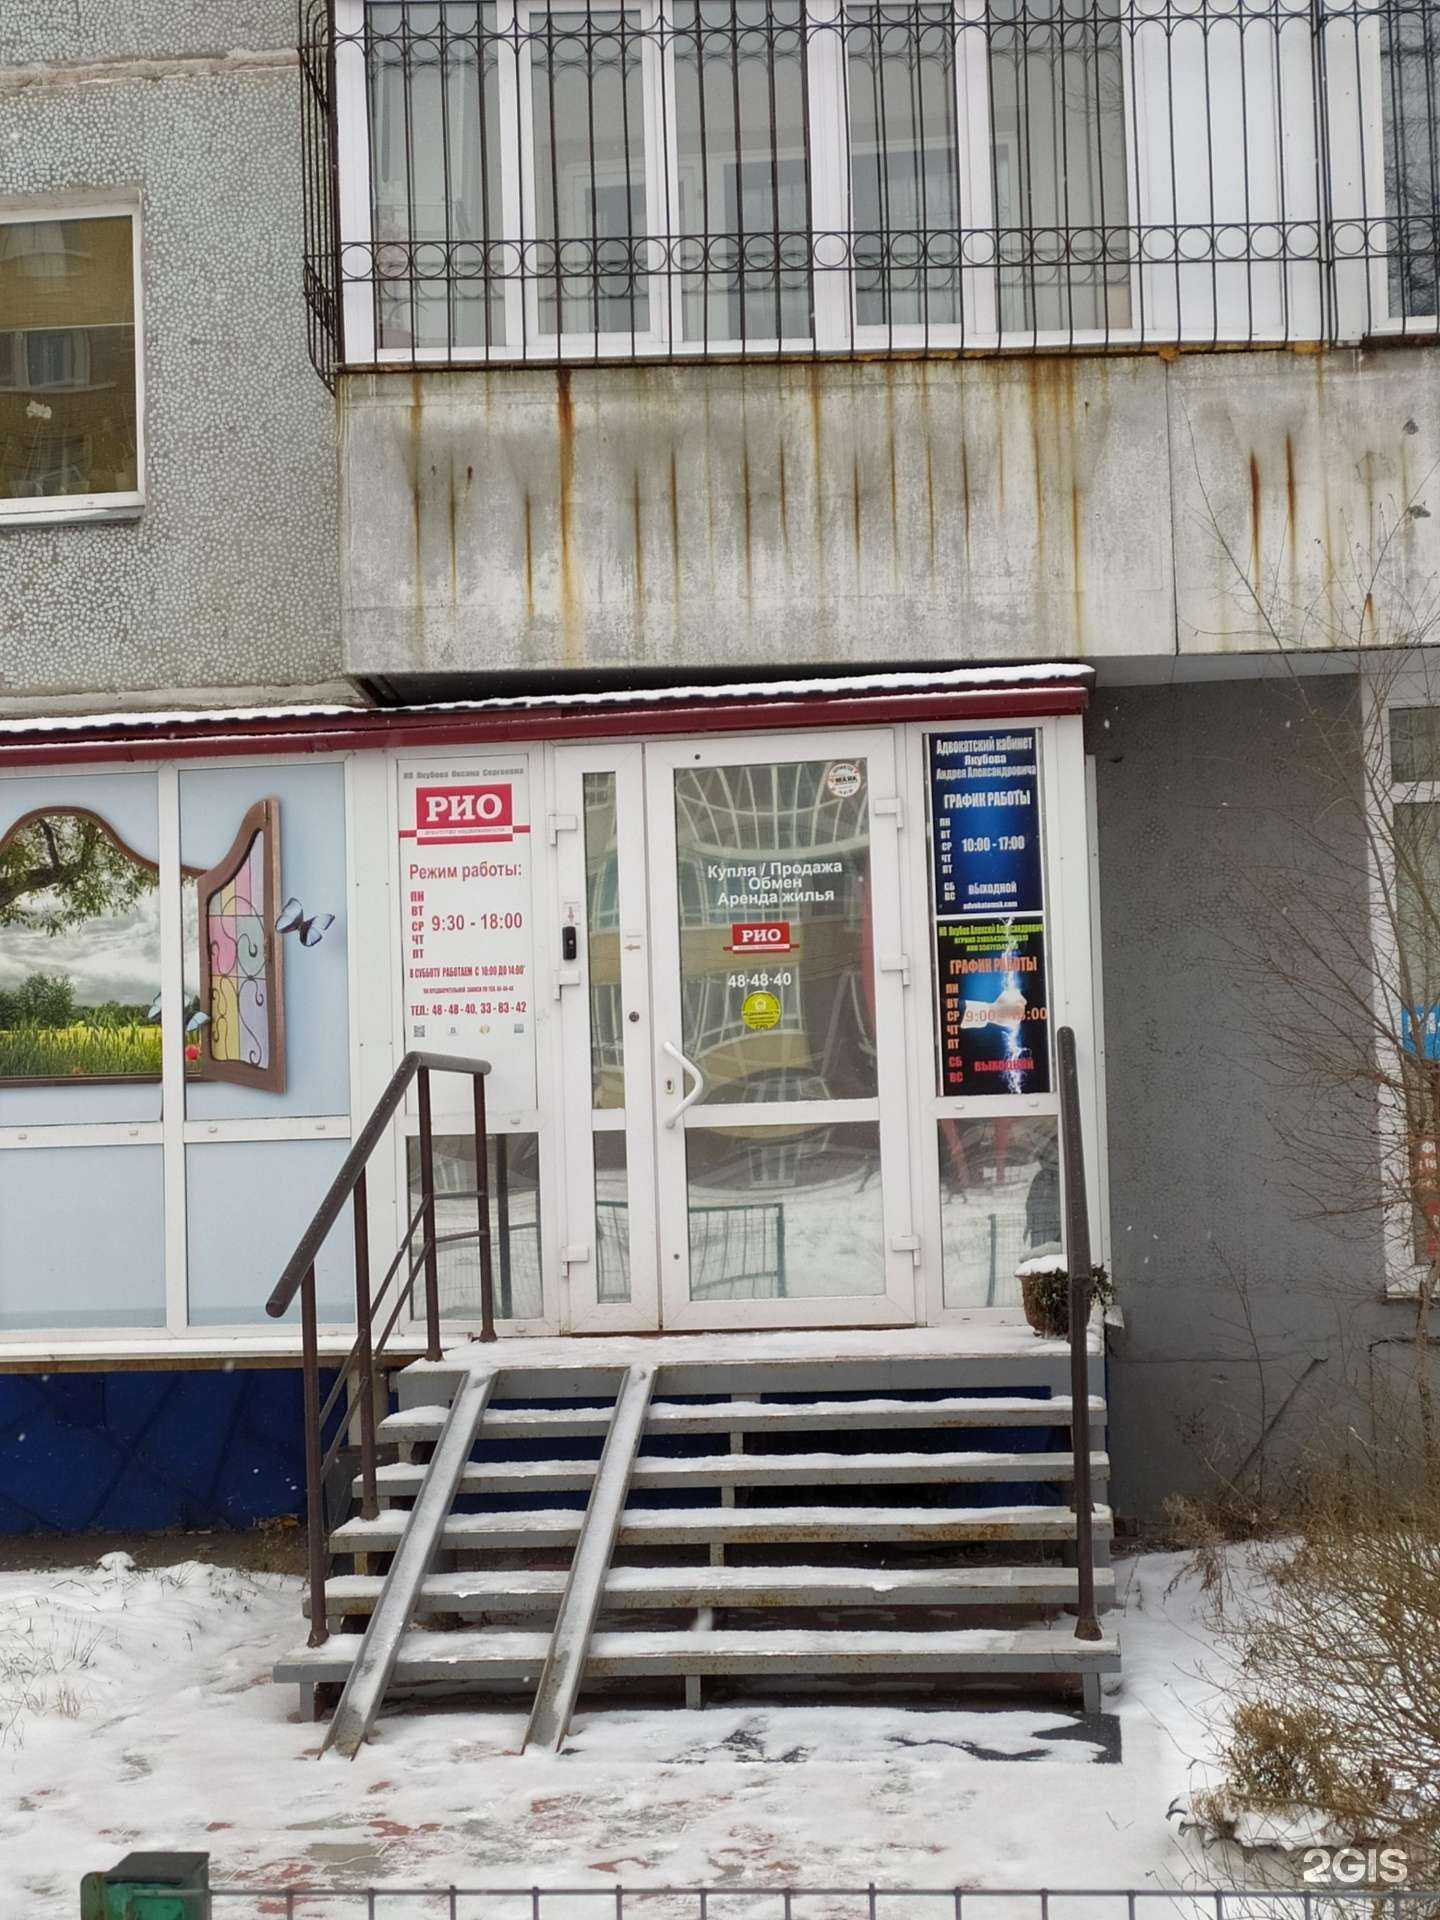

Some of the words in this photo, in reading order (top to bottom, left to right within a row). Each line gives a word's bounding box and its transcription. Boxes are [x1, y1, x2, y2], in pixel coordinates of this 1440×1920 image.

[937, 736, 995, 756] Адвокатский
[996, 736, 1033, 751] кабинет
[965, 754, 1007, 767] Якубова
[936, 768, 967, 781] Андрея
[944, 792, 986, 809] ГРАФИК
[987, 789, 1031, 806] РАБОТЫ
[426, 794, 503, 822] РИО
[940, 818, 950, 826] ПН
[941, 831, 951, 839] ВТ
[942, 842, 952, 851] СР
[962, 837, 991, 852] 10:00
[998, 836, 1025, 850] 17:00
[942, 854, 952, 863] ЧТ
[409, 864, 457, 880] Режим
[462, 861, 522, 881] работы:
[708, 865, 756, 880] Купля
[770, 862, 843, 877] Продажа
[943, 865, 953, 874] ПТ
[749, 876, 802, 890] Обмен
[944, 882, 955, 891] СБ
[410, 891, 424, 902] ПН
[718, 892, 778, 907] Аренда
[782, 890, 834, 903] жилья
[945, 892, 956, 901] ВС
[411, 906, 424, 916] ВТ
[412, 921, 424, 932] СР
[431, 915, 465, 931] 9:30
[481, 912, 523, 930] 18:00
[412, 935, 424, 945] ЧТ
[742, 929, 781, 942] РИО
[412, 949, 424, 959] ПТ
[950, 960, 992, 974] ГРАФИК
[994, 957, 1037, 972] РАБОТЫ
[415, 968, 440, 978] СУББОТУ
[442, 966, 472, 977] РАБОТАЕМ
[475, 967, 479, 976] С
[947, 999, 959, 1008] ВТ
[947, 1011, 959, 1021] СР
[947, 1025, 959, 1035] ЧТ
[948, 1039, 959, 1048] ПТ
[949, 1057, 962, 1067] СБ
[950, 1072, 963, 1082] ВС
